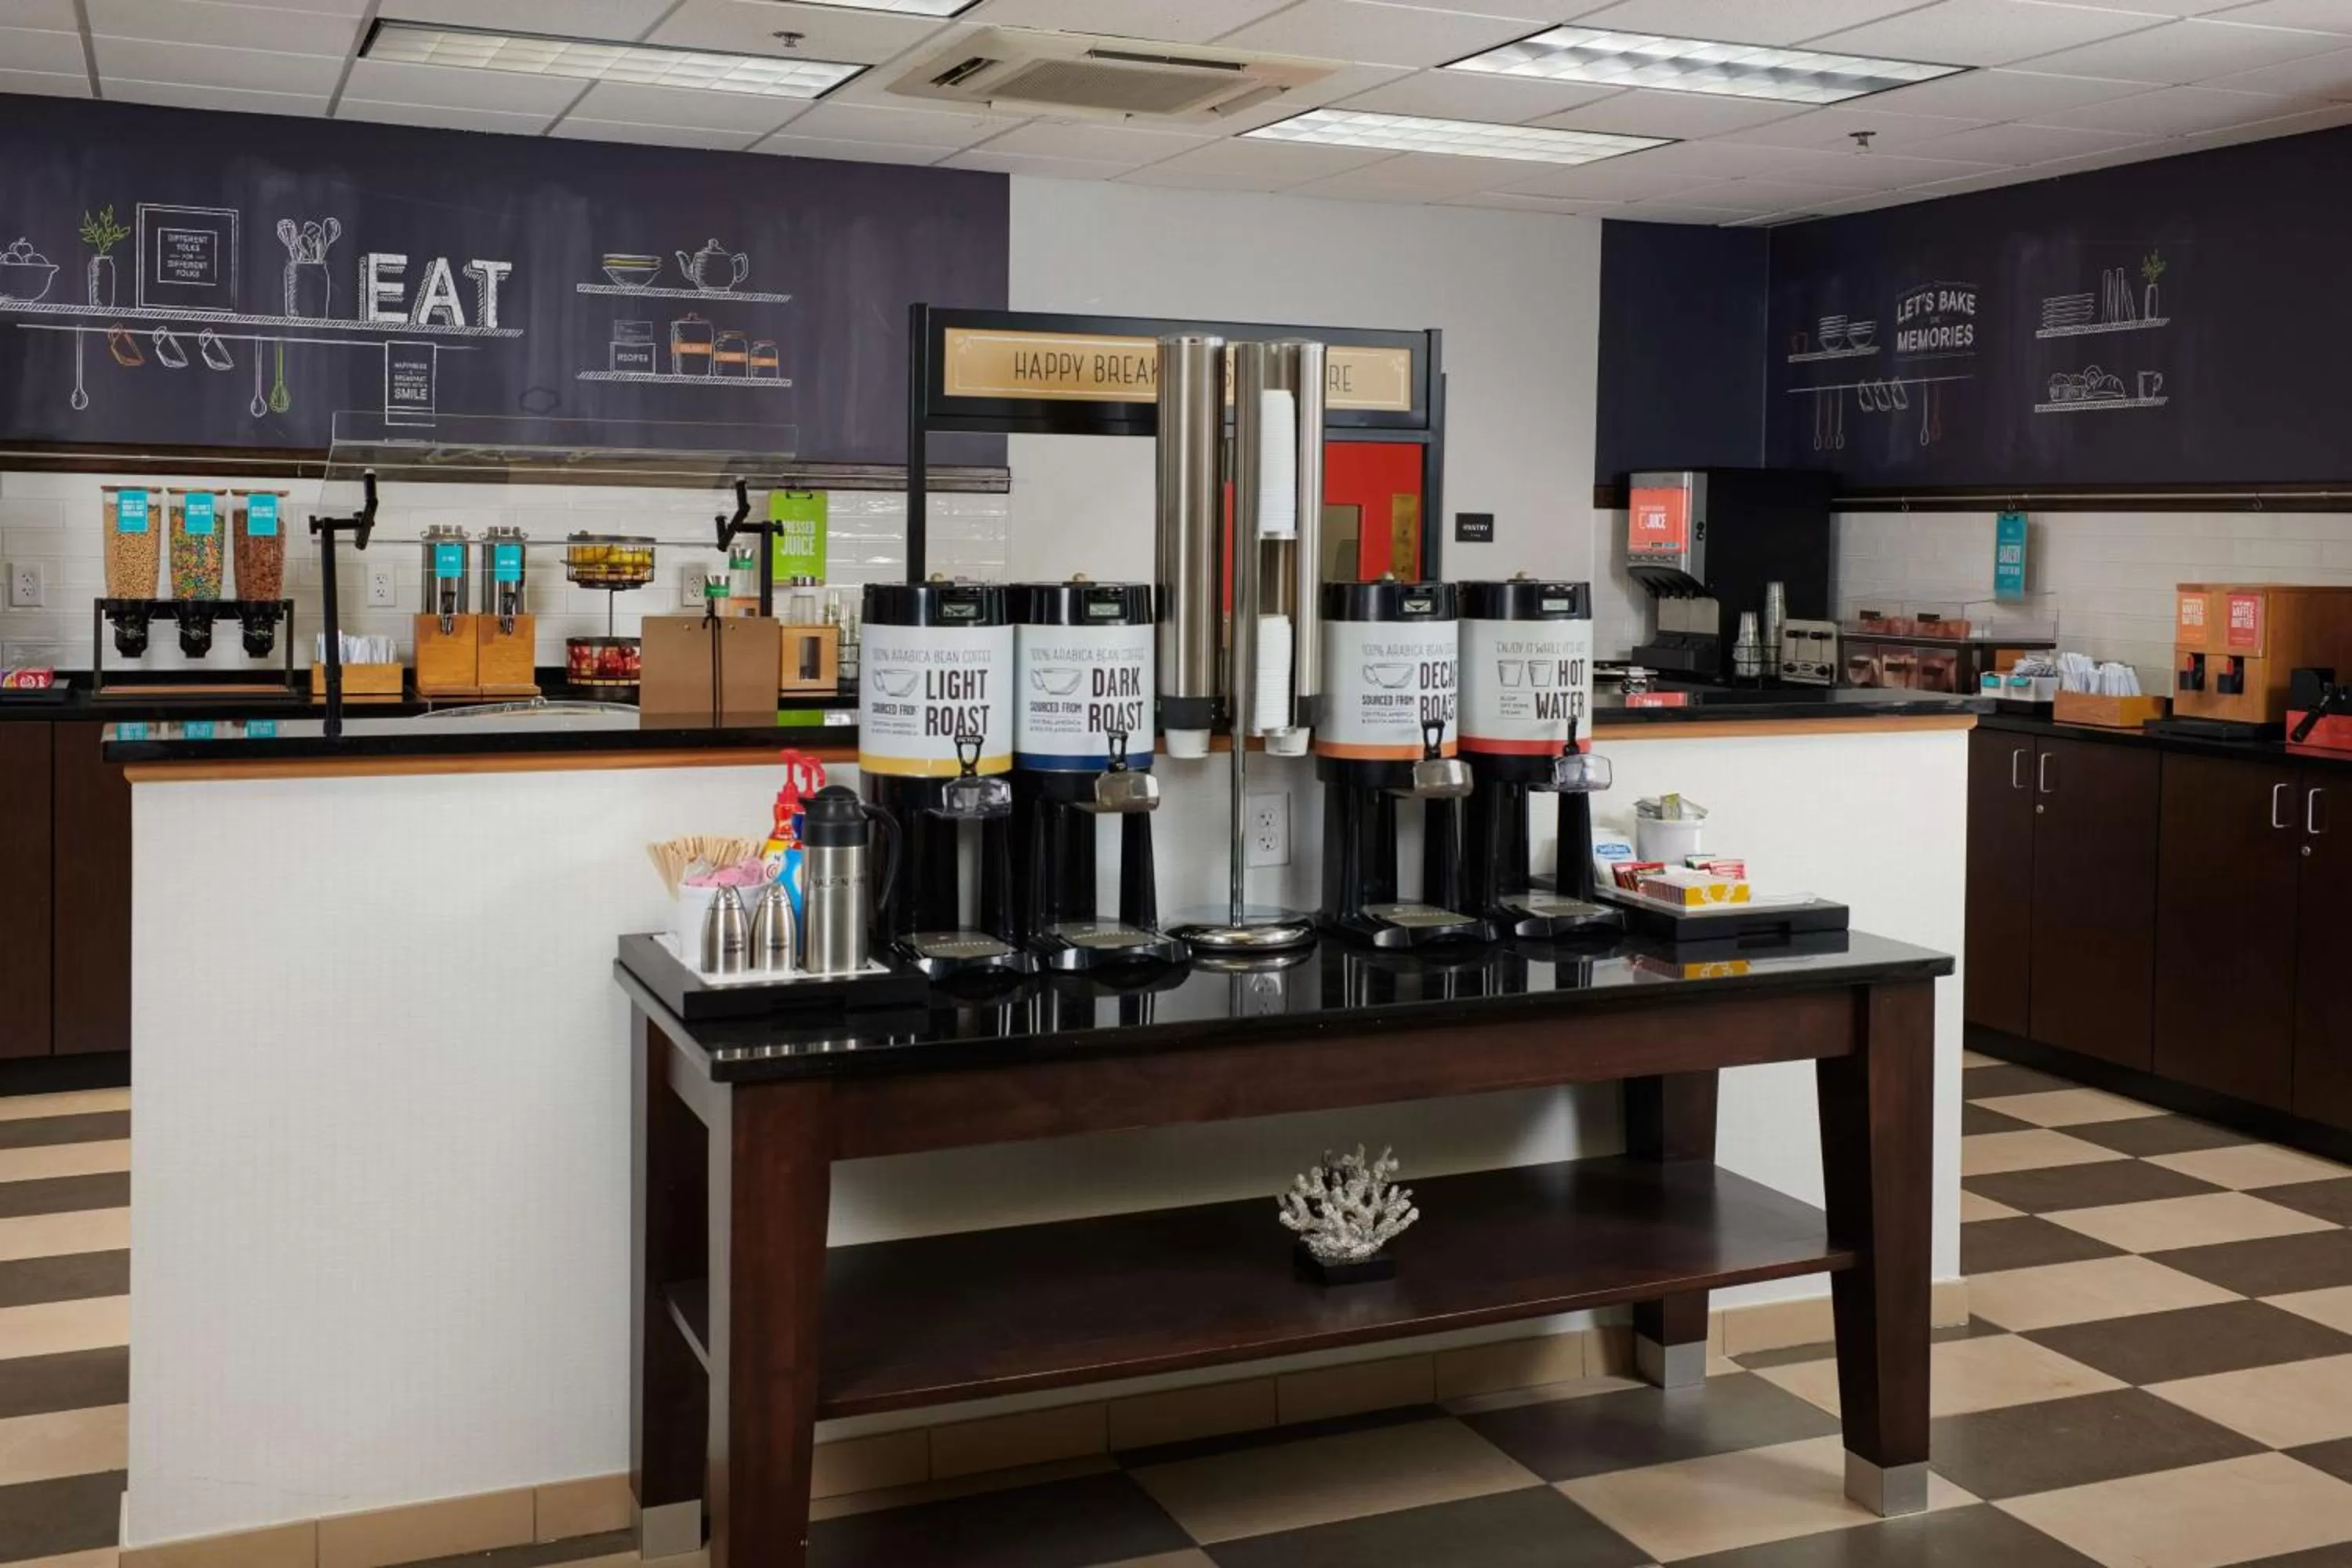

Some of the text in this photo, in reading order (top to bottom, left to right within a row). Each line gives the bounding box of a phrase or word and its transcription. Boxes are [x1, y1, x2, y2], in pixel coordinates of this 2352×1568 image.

[358, 252, 512, 328] EAT
[1897, 290, 1976, 325] LET'S BAKE
[1897, 324, 1973, 352] MEMORIES
[616, 353, 649, 370] RECIPES
[1015, 350, 1084, 383] HAPPY
[394, 388, 427, 401] SMILE
[780, 535, 816, 556] JUICE
[891, 648, 931, 664] ARABICA
[934, 650, 959, 664] BEAN
[1053, 647, 1093, 662] ARABICA
[1386, 643, 1425, 657] ARABICA
[926, 669, 989, 700] LIGHT
[1092, 668, 1141, 698] DARK
[1558, 659, 1584, 687] HOT
[1029, 700, 1083, 713] SOURCED FROM
[1362, 694, 1414, 706] SOURCED FROM
[1535, 691, 1584, 720] WATER
[925, 705, 990, 736] ROAST
[1088, 701, 1143, 733] ROAST
